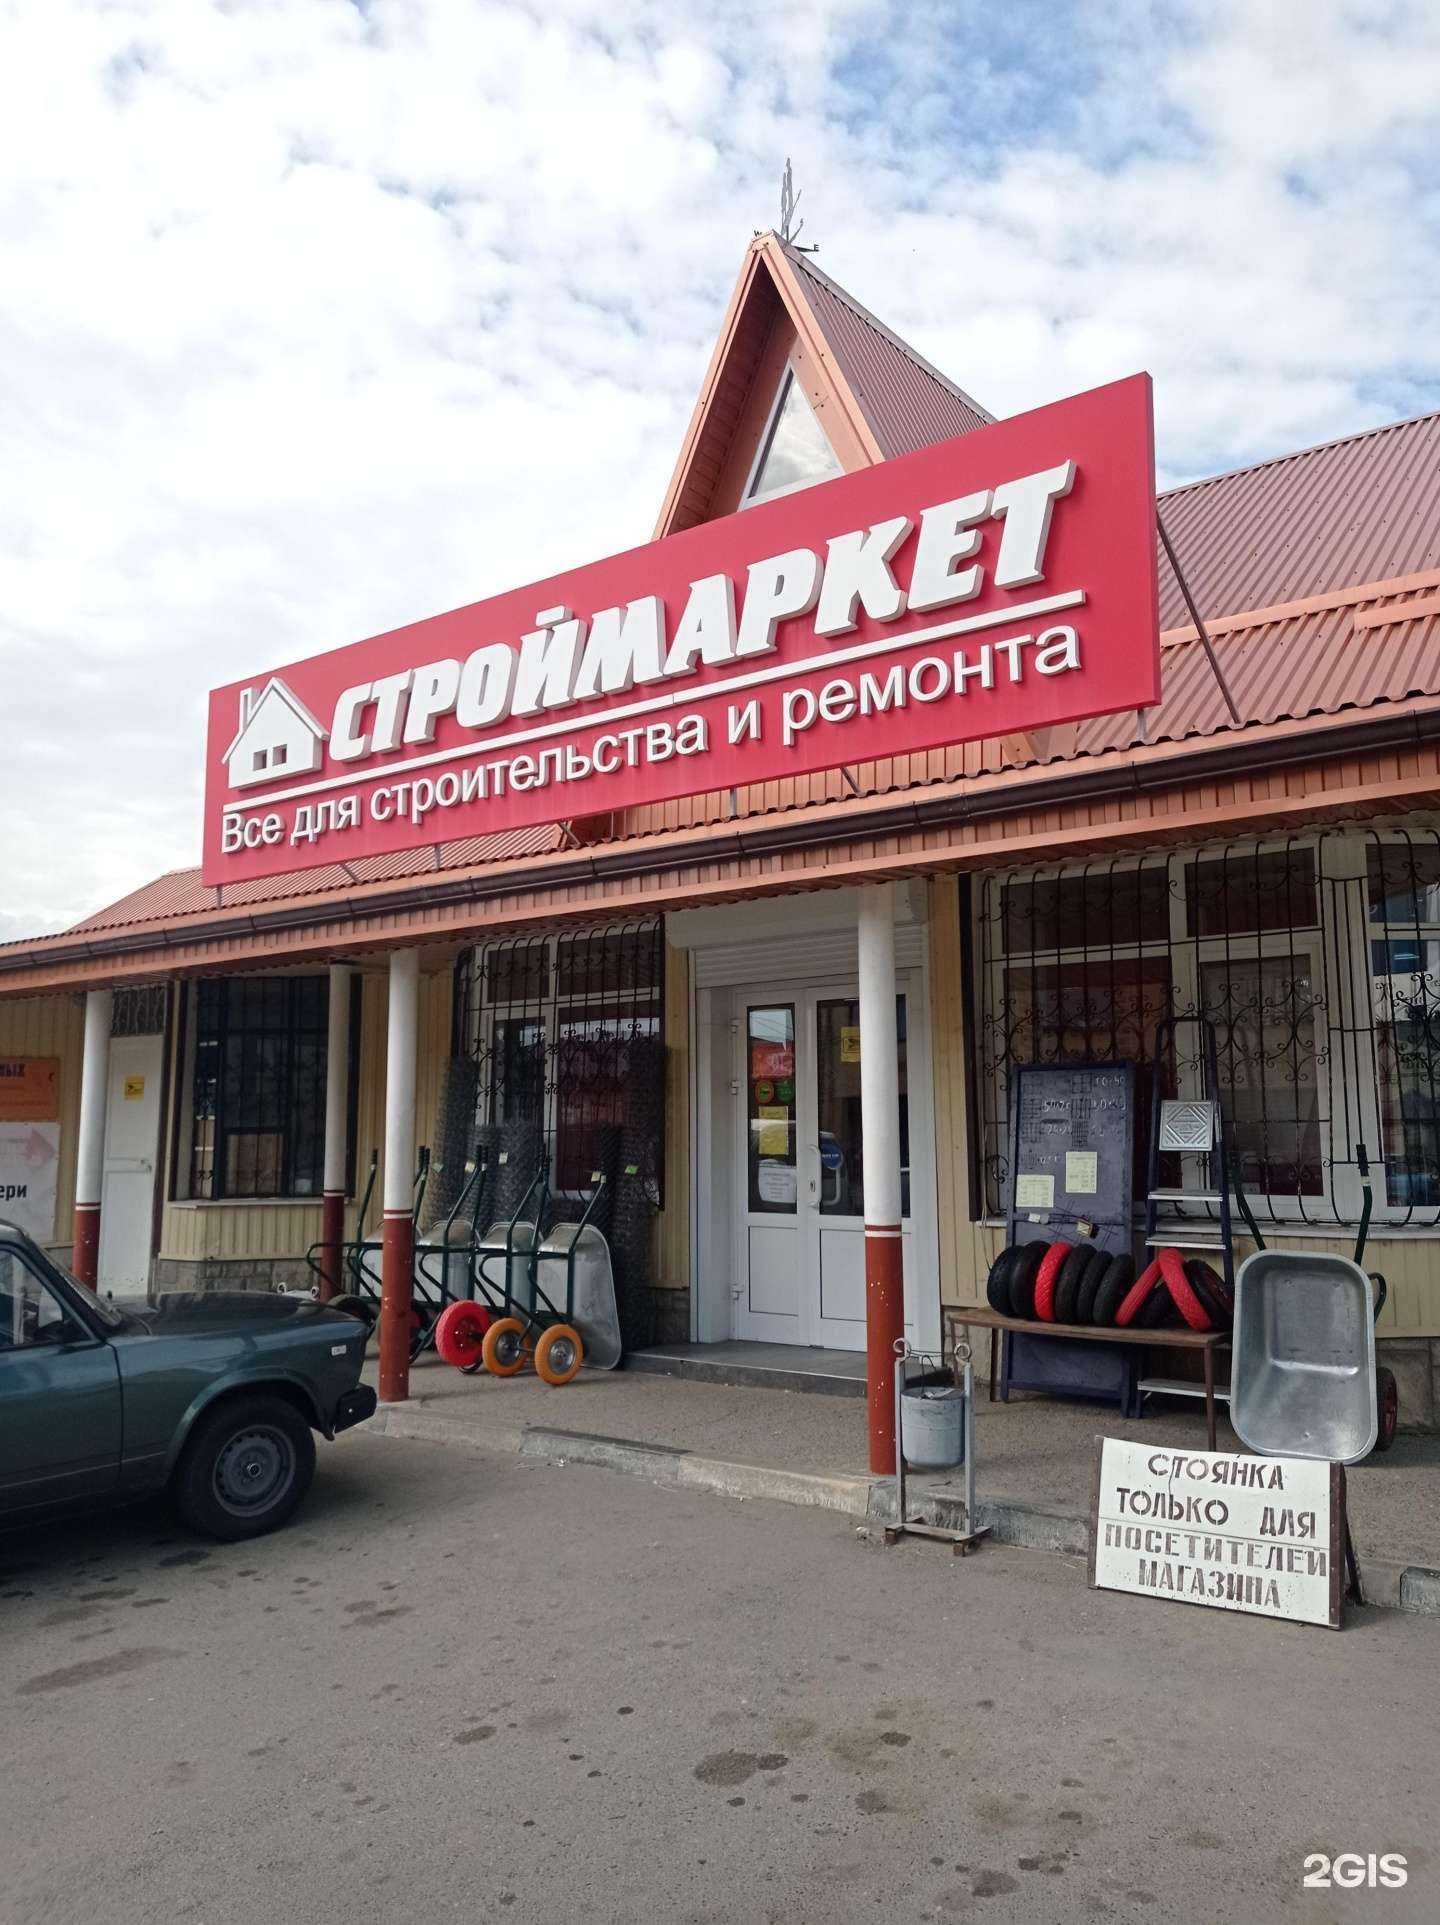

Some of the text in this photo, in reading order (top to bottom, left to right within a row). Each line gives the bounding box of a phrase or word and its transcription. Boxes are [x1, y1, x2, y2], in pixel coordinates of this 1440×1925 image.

[329, 459, 1077, 762] СТРОЙМАРКЕТ
[222, 624, 1082, 854] Все для строительства и ремонта
[1149, 1454, 1284, 1490] СТОЯНКА
[1116, 1487, 1316, 1539] ТОЛЬКО ДЛЯ
[1105, 1523, 1327, 1577] ПОСЕТИТЕЛЕЙ
[1139, 1558, 1281, 1609] МАГАЗИНА
